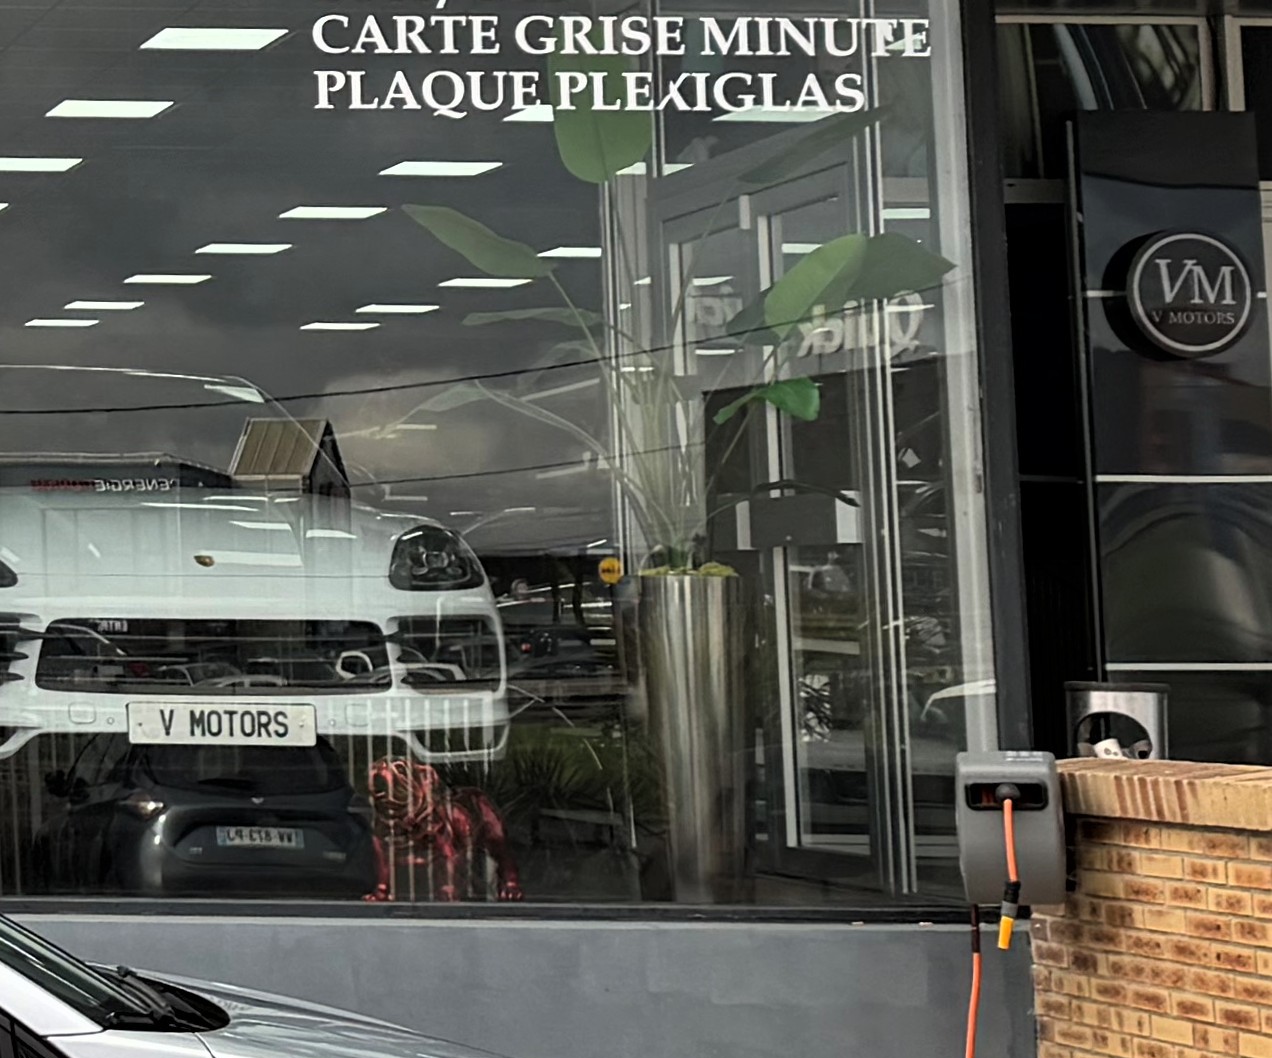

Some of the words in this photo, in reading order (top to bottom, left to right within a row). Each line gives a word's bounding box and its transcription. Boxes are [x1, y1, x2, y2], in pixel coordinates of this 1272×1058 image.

[312, 15, 499, 55] CARTE
[515, 16, 685, 55] GRISE
[699, 17, 931, 57] MINUTE
[313, 70, 541, 118] PLAQUE
[555, 71, 865, 113] PLEXIGLAS
[1155, 259, 1236, 305] VM
[1168, 310, 1235, 325] MOTORS
[160, 709, 174, 736] V
[190, 710, 289, 739] MOTORS
